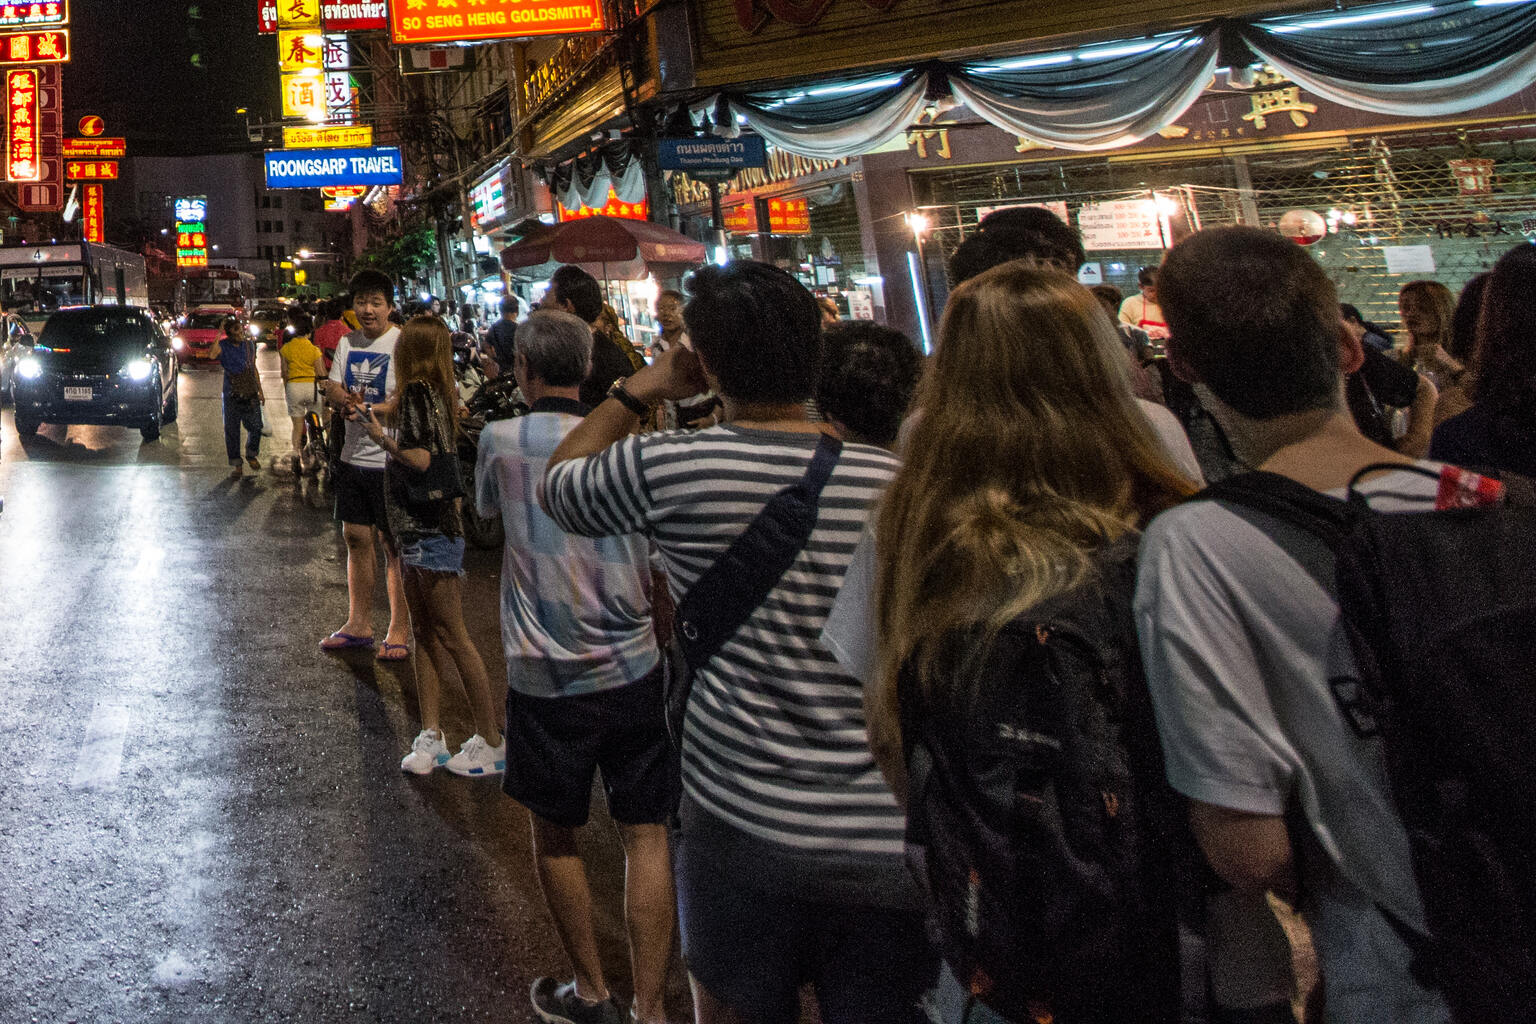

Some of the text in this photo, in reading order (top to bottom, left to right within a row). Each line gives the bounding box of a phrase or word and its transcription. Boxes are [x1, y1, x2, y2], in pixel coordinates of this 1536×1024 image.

[402, 6, 592, 30] SO SENG HENG GOLDSMITH
[268, 155, 399, 177] ROONGSARP TRAVEL
[33, 248, 41, 260] 4
[349, 383, 379, 396] adas
